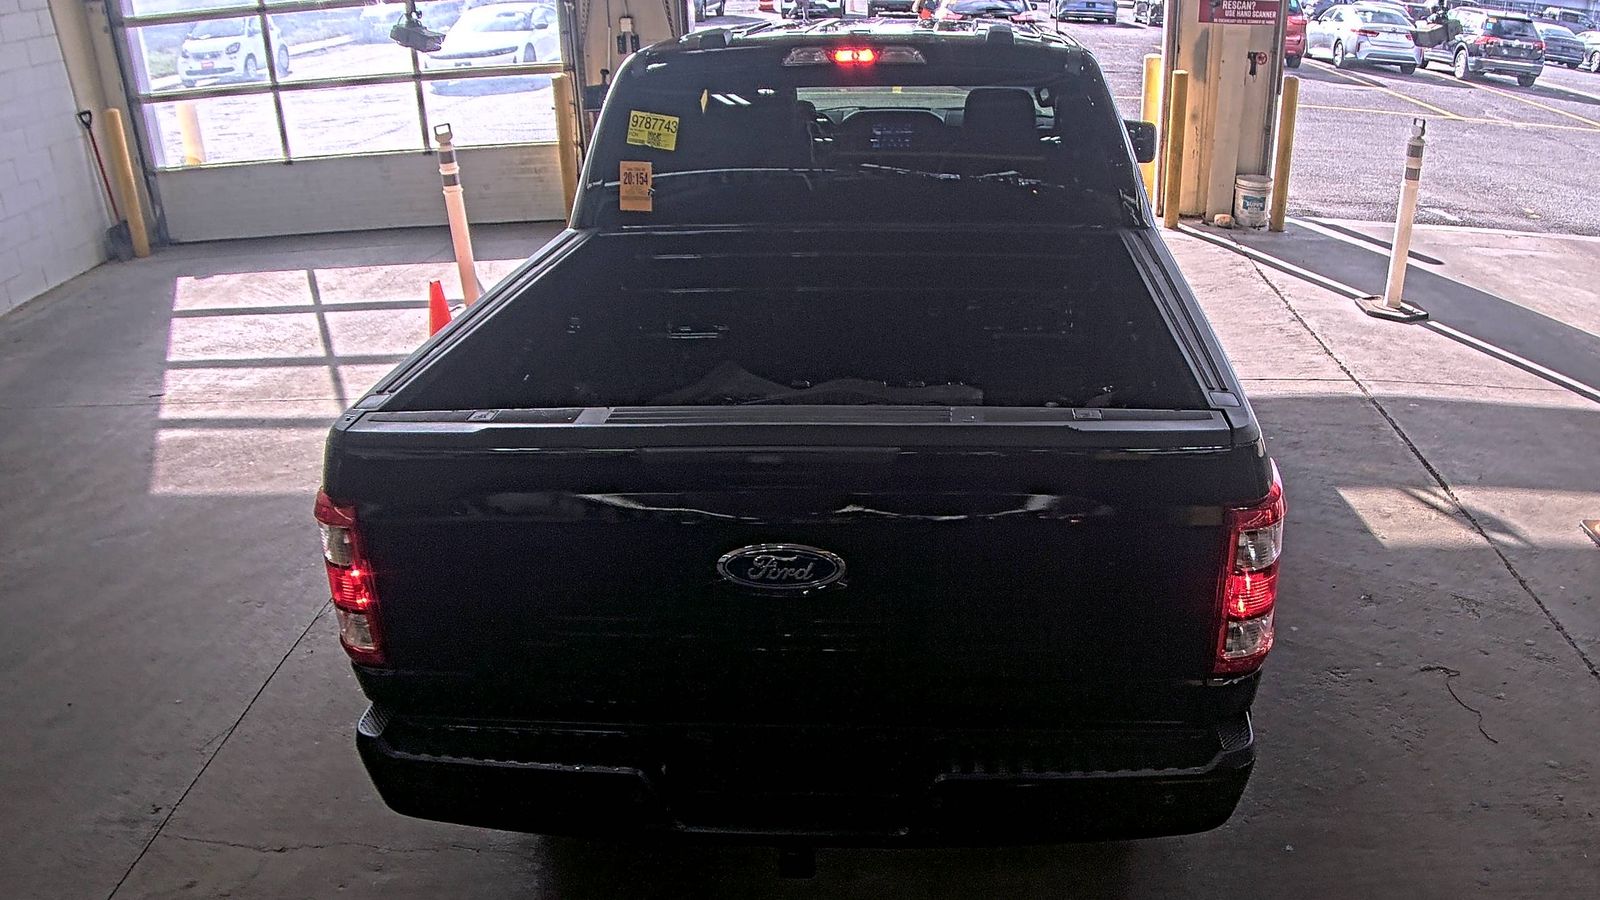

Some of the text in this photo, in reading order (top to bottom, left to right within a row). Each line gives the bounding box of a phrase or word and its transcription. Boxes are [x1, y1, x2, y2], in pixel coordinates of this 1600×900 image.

[1222, 1, 1257, 10] RESCAN?
[1236, 10, 1252, 18] HAND
[631, 114, 678, 134] 9787743
[747, 554, 814, 580] Ford
